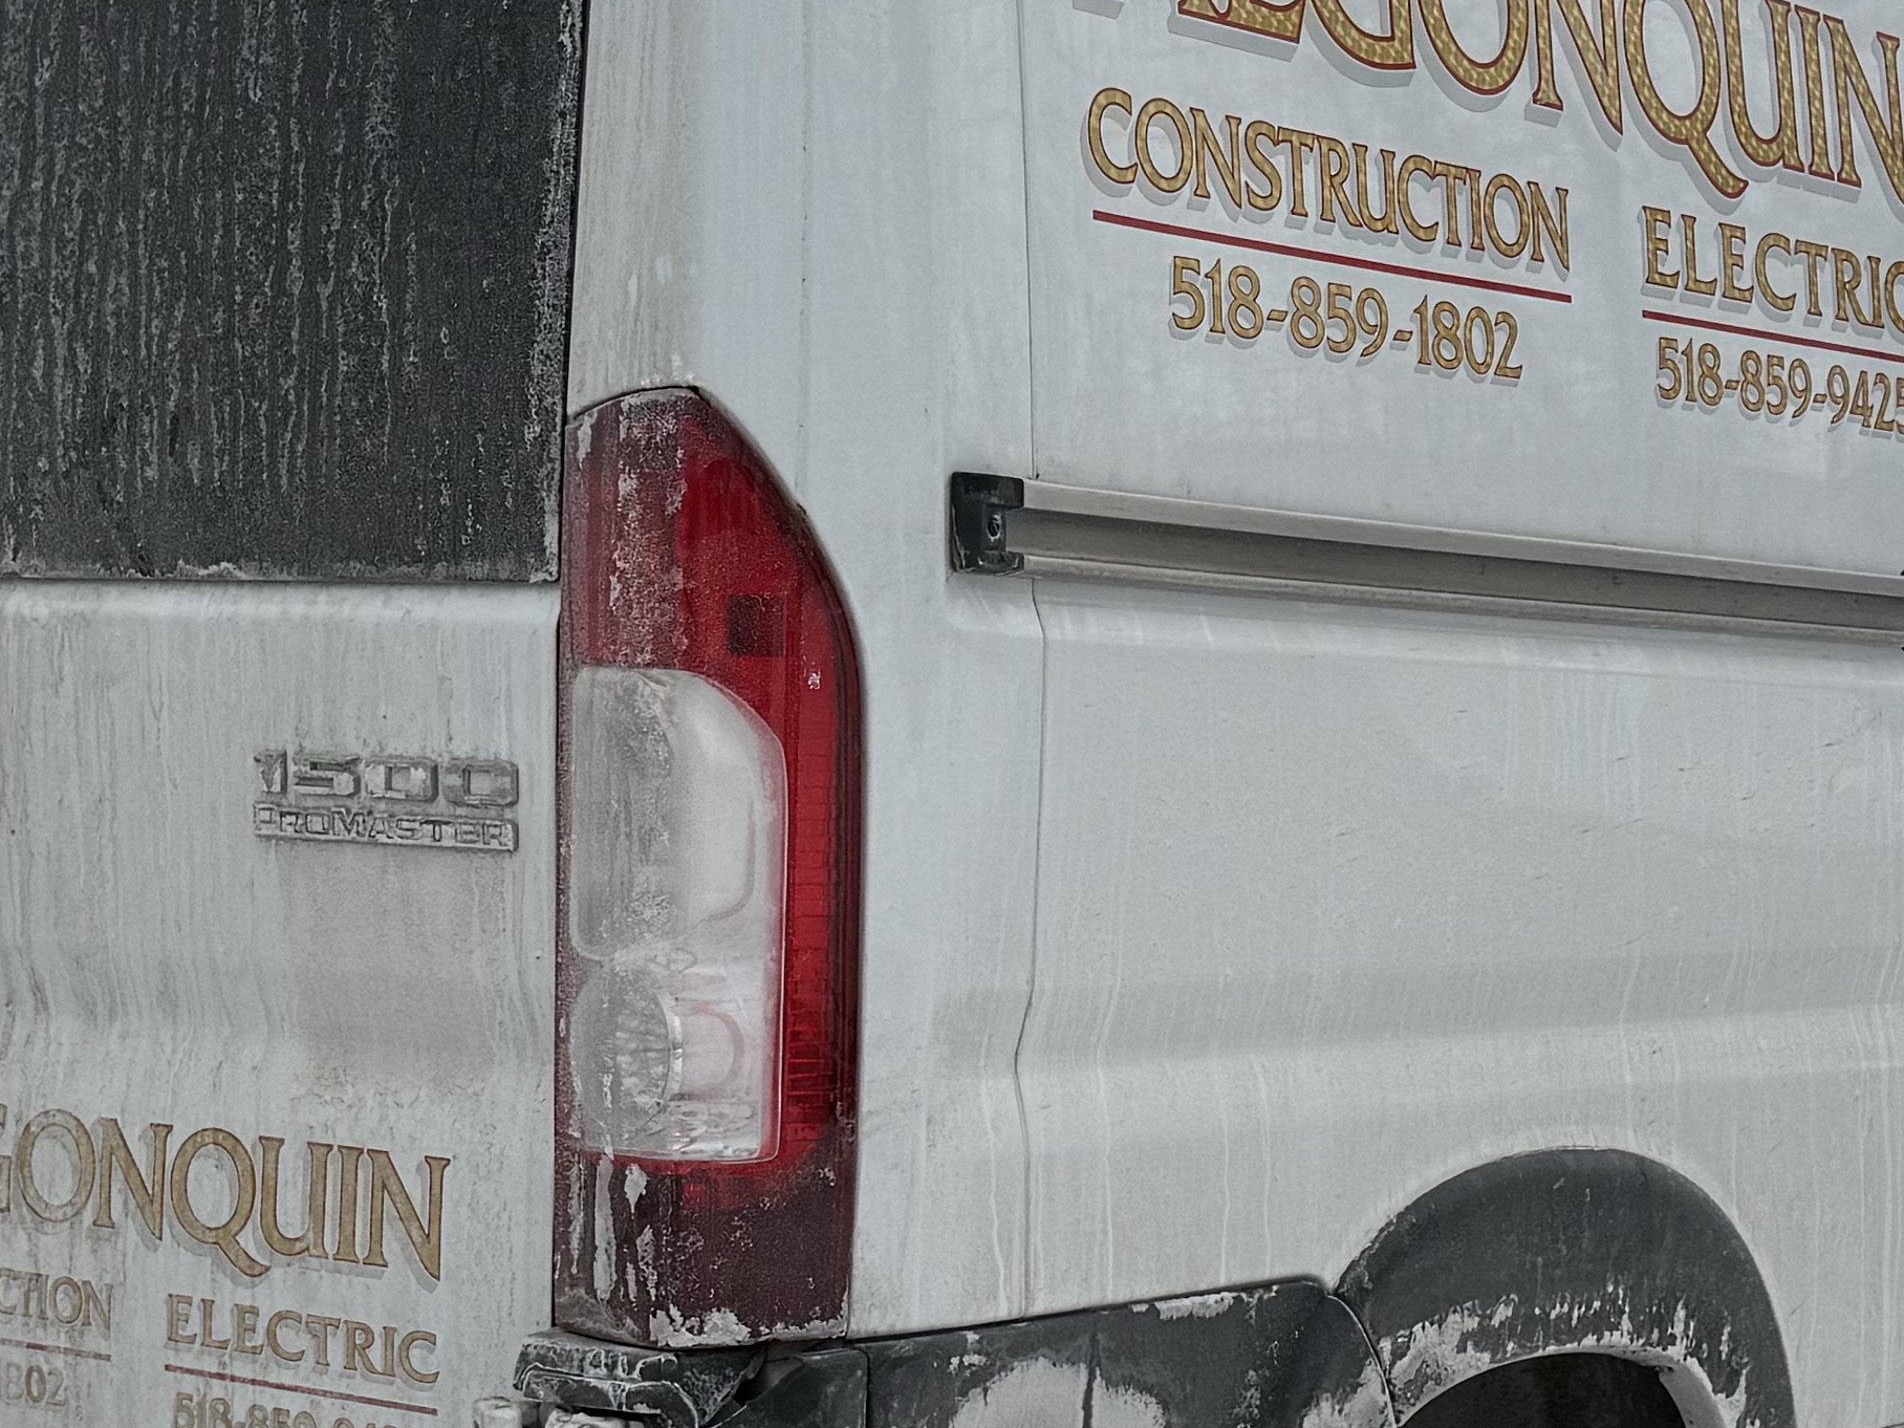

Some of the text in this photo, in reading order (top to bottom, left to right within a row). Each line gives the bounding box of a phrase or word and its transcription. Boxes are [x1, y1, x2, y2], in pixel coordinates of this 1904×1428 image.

[1087, 87, 1571, 274] CONSTRUCTION
[1170, 254, 1523, 380] 518-859-1802
[252, 748, 520, 809] 1500
[253, 803, 518, 852] PROMASTER
[167, 1292, 440, 1384] ELECTRIC
